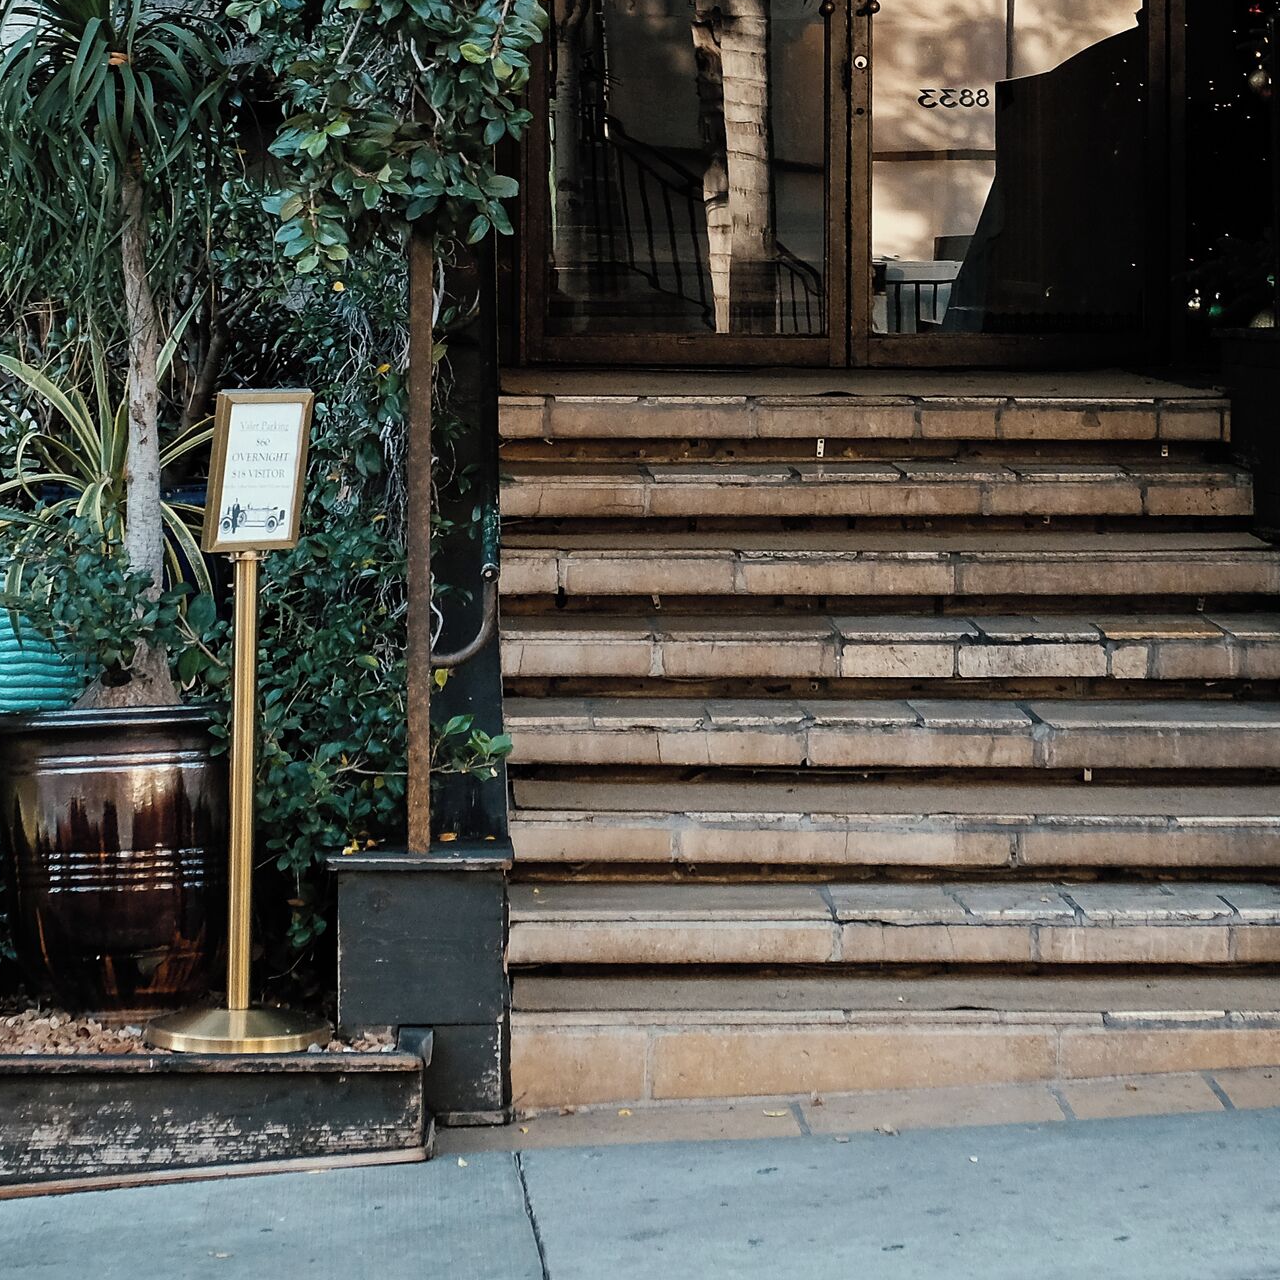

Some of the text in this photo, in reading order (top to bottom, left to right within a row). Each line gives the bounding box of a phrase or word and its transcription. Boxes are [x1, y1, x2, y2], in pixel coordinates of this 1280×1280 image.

[261, 421, 289, 432] Parking
[231, 452, 290, 462] OVERNIGHT
[248, 468, 286, 479] VISITOR
